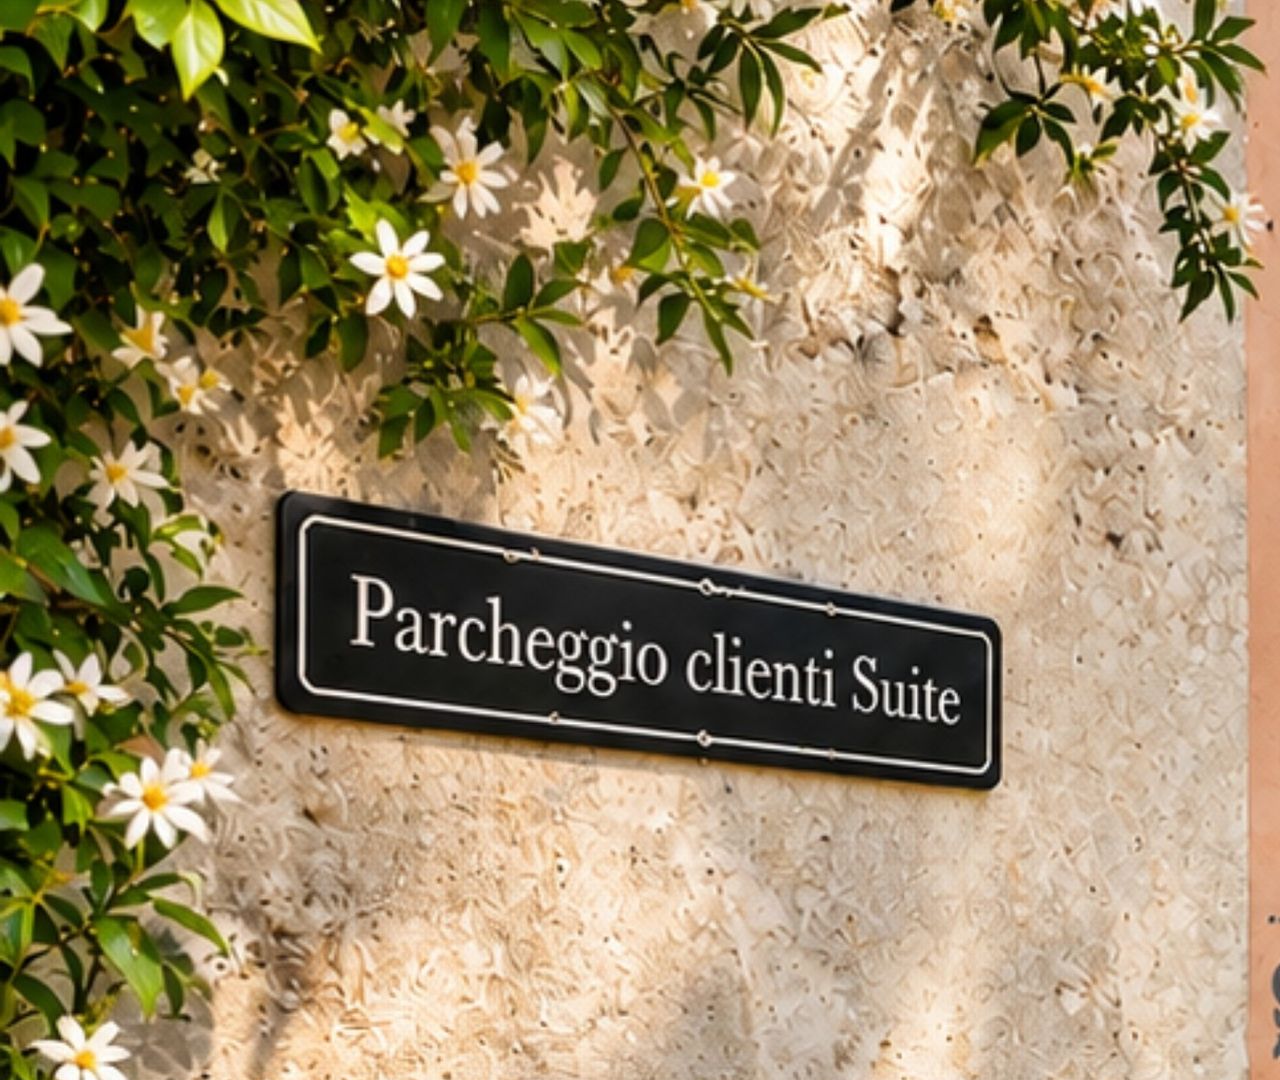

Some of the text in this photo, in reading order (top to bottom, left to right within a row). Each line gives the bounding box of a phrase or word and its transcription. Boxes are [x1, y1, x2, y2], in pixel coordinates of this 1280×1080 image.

[350, 574, 961, 725] Parcheggio clienti Suite
